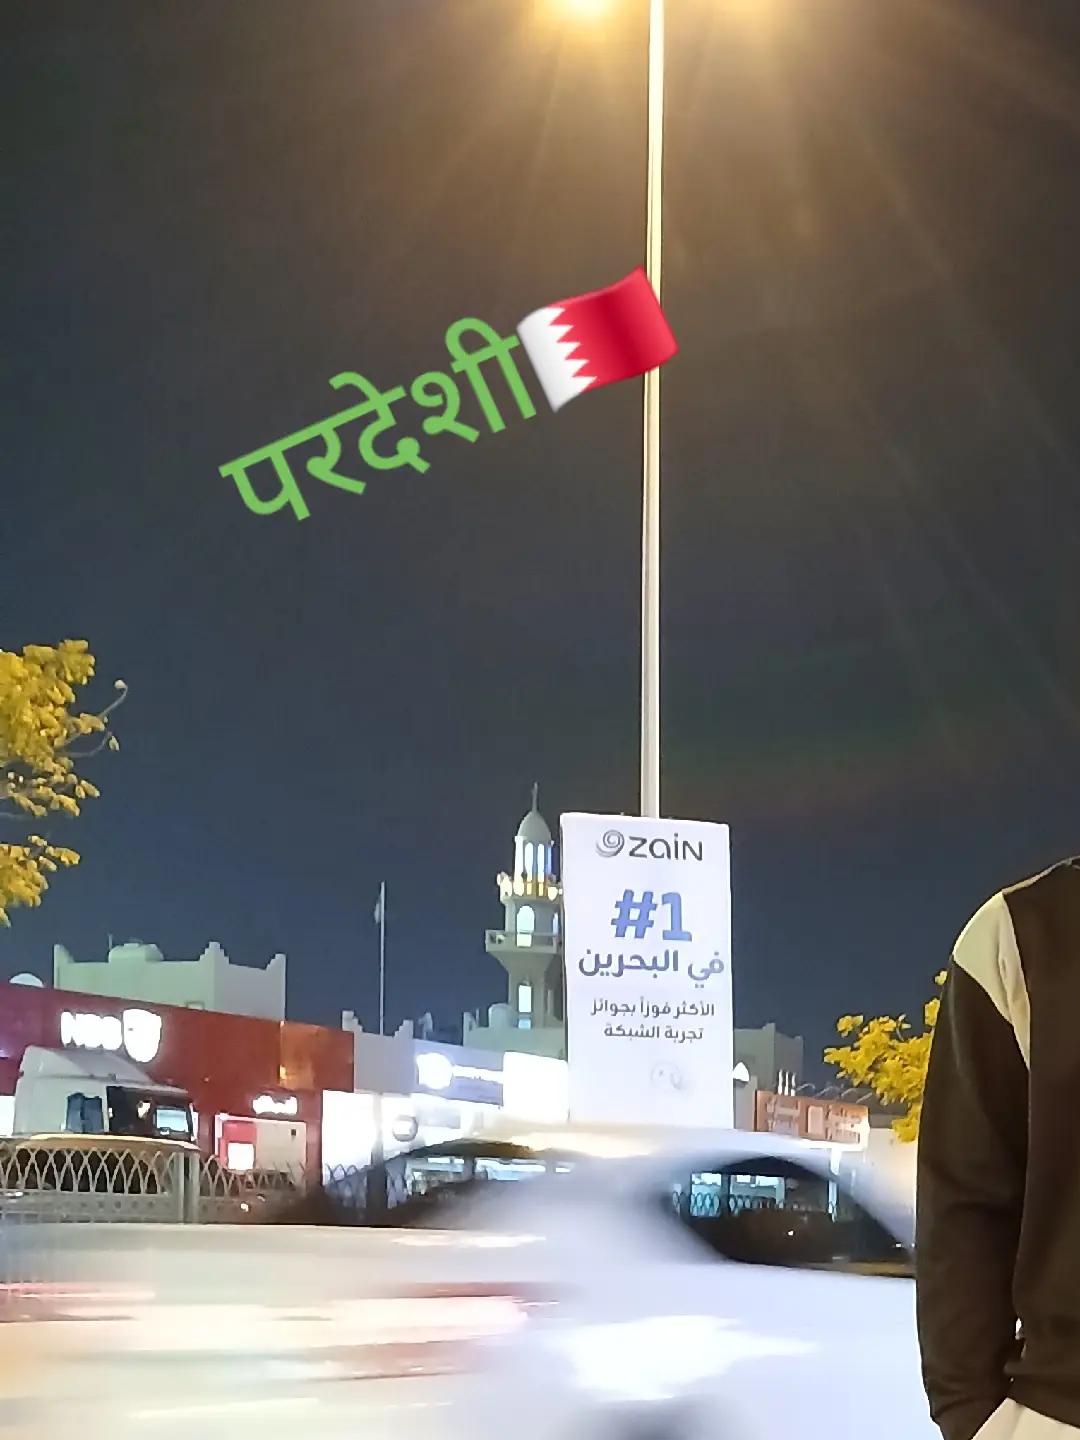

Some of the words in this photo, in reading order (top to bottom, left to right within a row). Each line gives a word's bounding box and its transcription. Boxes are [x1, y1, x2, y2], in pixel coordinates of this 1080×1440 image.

[611, 889, 692, 942] #1
[578, 949, 679, 978] البحرين
[687, 951, 724, 988] في
[604, 1023, 660, 1041] الشبكة
[664, 1025, 703, 1043] تجربة
